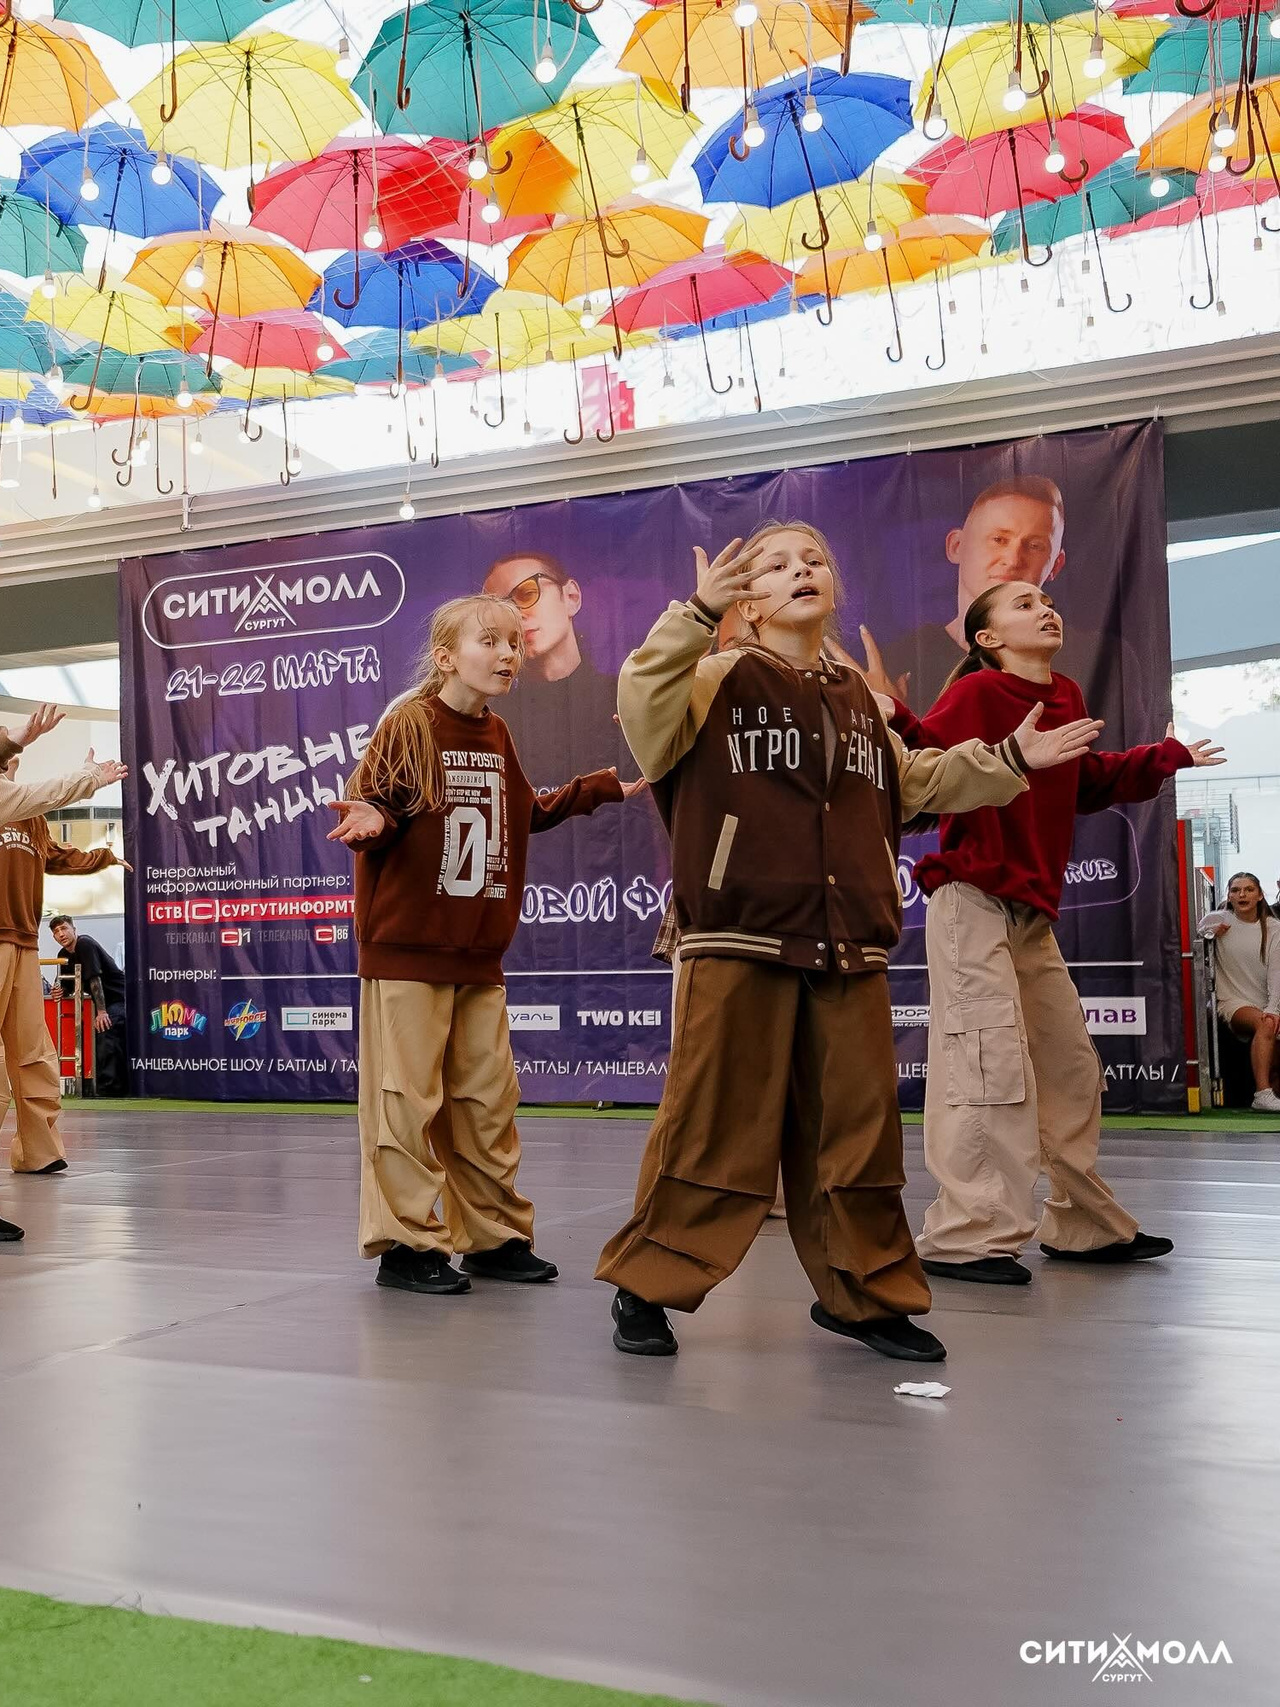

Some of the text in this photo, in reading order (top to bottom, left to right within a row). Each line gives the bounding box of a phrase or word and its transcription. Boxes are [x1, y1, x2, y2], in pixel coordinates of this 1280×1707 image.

[244, 617, 286, 631] СУРГУТ
[165, 646, 380, 701] 21-22 МАРТА
[442, 750, 505, 773] STAY POSITI
[193, 773, 345, 847] ТАНЦЫ
[146, 862, 236, 880] Генеральный
[147, 874, 350, 895] информационный партнер:
[519, 875, 617, 924] ОВОЙ
[165, 931, 216, 944] ТЕЛЕКАНАЛ
[258, 928, 310, 942] ТЕЛЕКАНАЛ
[148, 968, 217, 983] Партнеры:
[312, 1011, 348, 1019] синема
[509, 1013, 554, 1023] уаль
[576, 1010, 662, 1026] TWO KEI
[892, 1009, 930, 1017] ФОР
[1085, 1009, 1137, 1023] лав
[312, 1018, 336, 1027] парк
[164, 1026, 189, 1037] парк
[131, 1057, 227, 1073] ТАНЦЕВАЛЬНОЕ
[230, 1058, 265, 1072] ШОУ
[277, 1059, 327, 1072] БАТТЛЫ
[340, 1059, 359, 1072] ТА
[585, 1061, 668, 1077] ТАНЦЕВАЛ
[1104, 1064, 1164, 1080] АТТЛЫ
